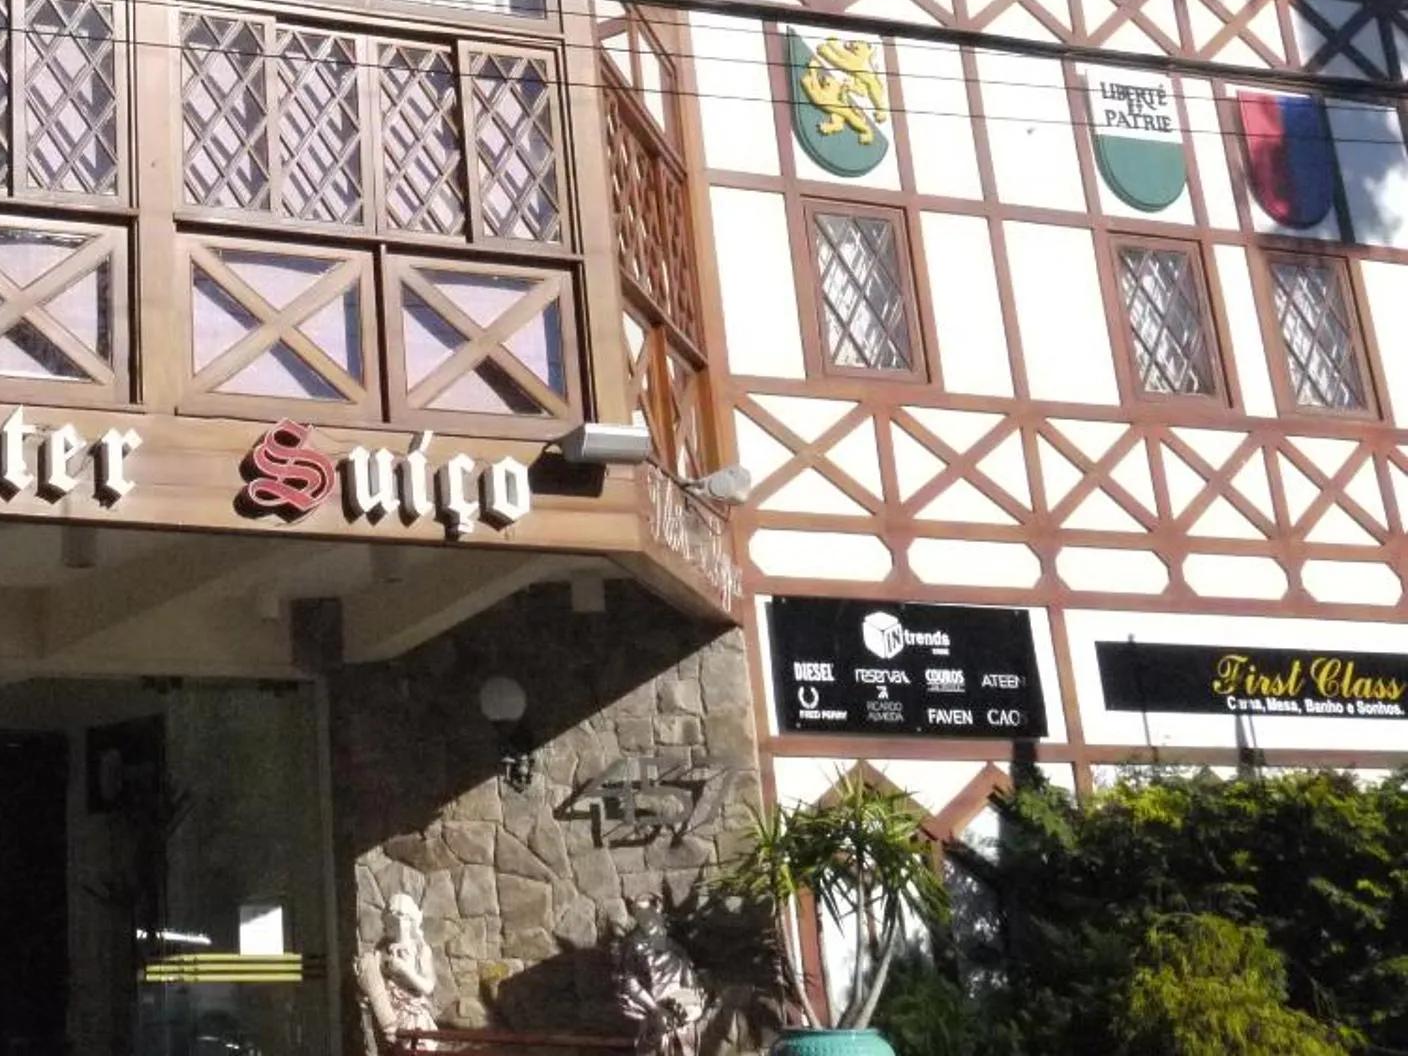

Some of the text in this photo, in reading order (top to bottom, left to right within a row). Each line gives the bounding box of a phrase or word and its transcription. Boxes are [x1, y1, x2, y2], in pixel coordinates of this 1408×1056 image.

[1104, 109, 1173, 133] PATRIE
[244, 416, 535, 538] Suíço
[794, 661, 835, 682] DIESEL
[1212, 653, 1408, 701] First Class
[927, 708, 974, 725] FAVEN
[1304, 698, 1344, 714] Banho
